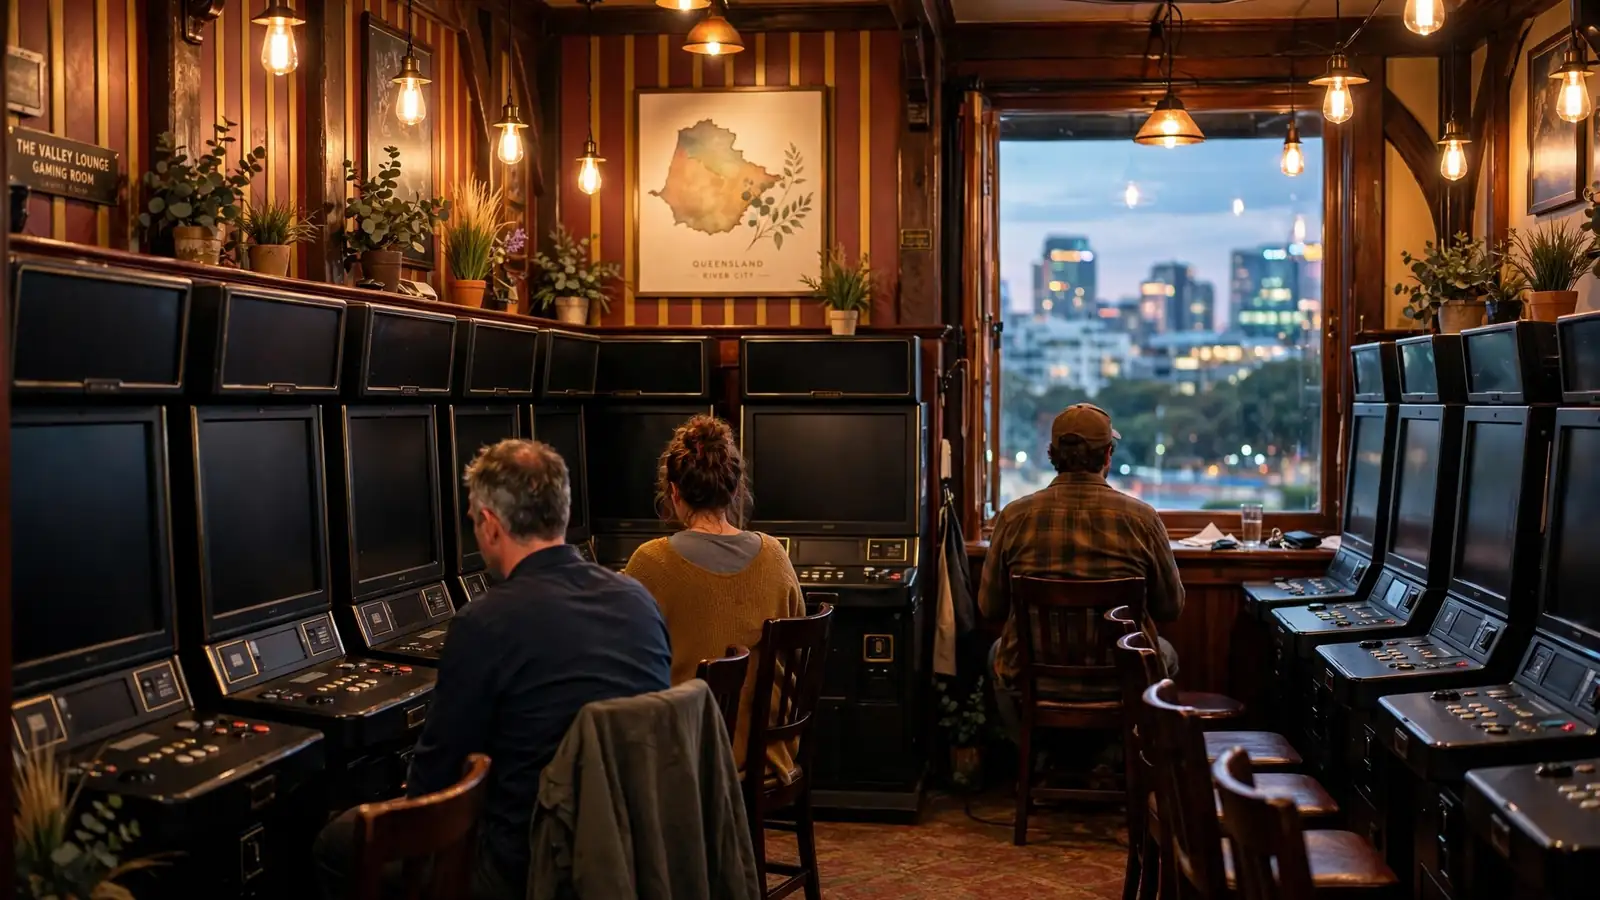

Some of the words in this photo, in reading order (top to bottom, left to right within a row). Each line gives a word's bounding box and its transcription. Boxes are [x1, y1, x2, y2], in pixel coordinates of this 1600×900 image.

[17, 138, 36, 156] THE
[39, 144, 73, 164] VALLEY
[76, 152, 110, 172] LOUNGE
[32, 160, 67, 180] GAMING
[70, 169, 94, 185] ROOM
[692, 260, 764, 268] QUEENSLAND
